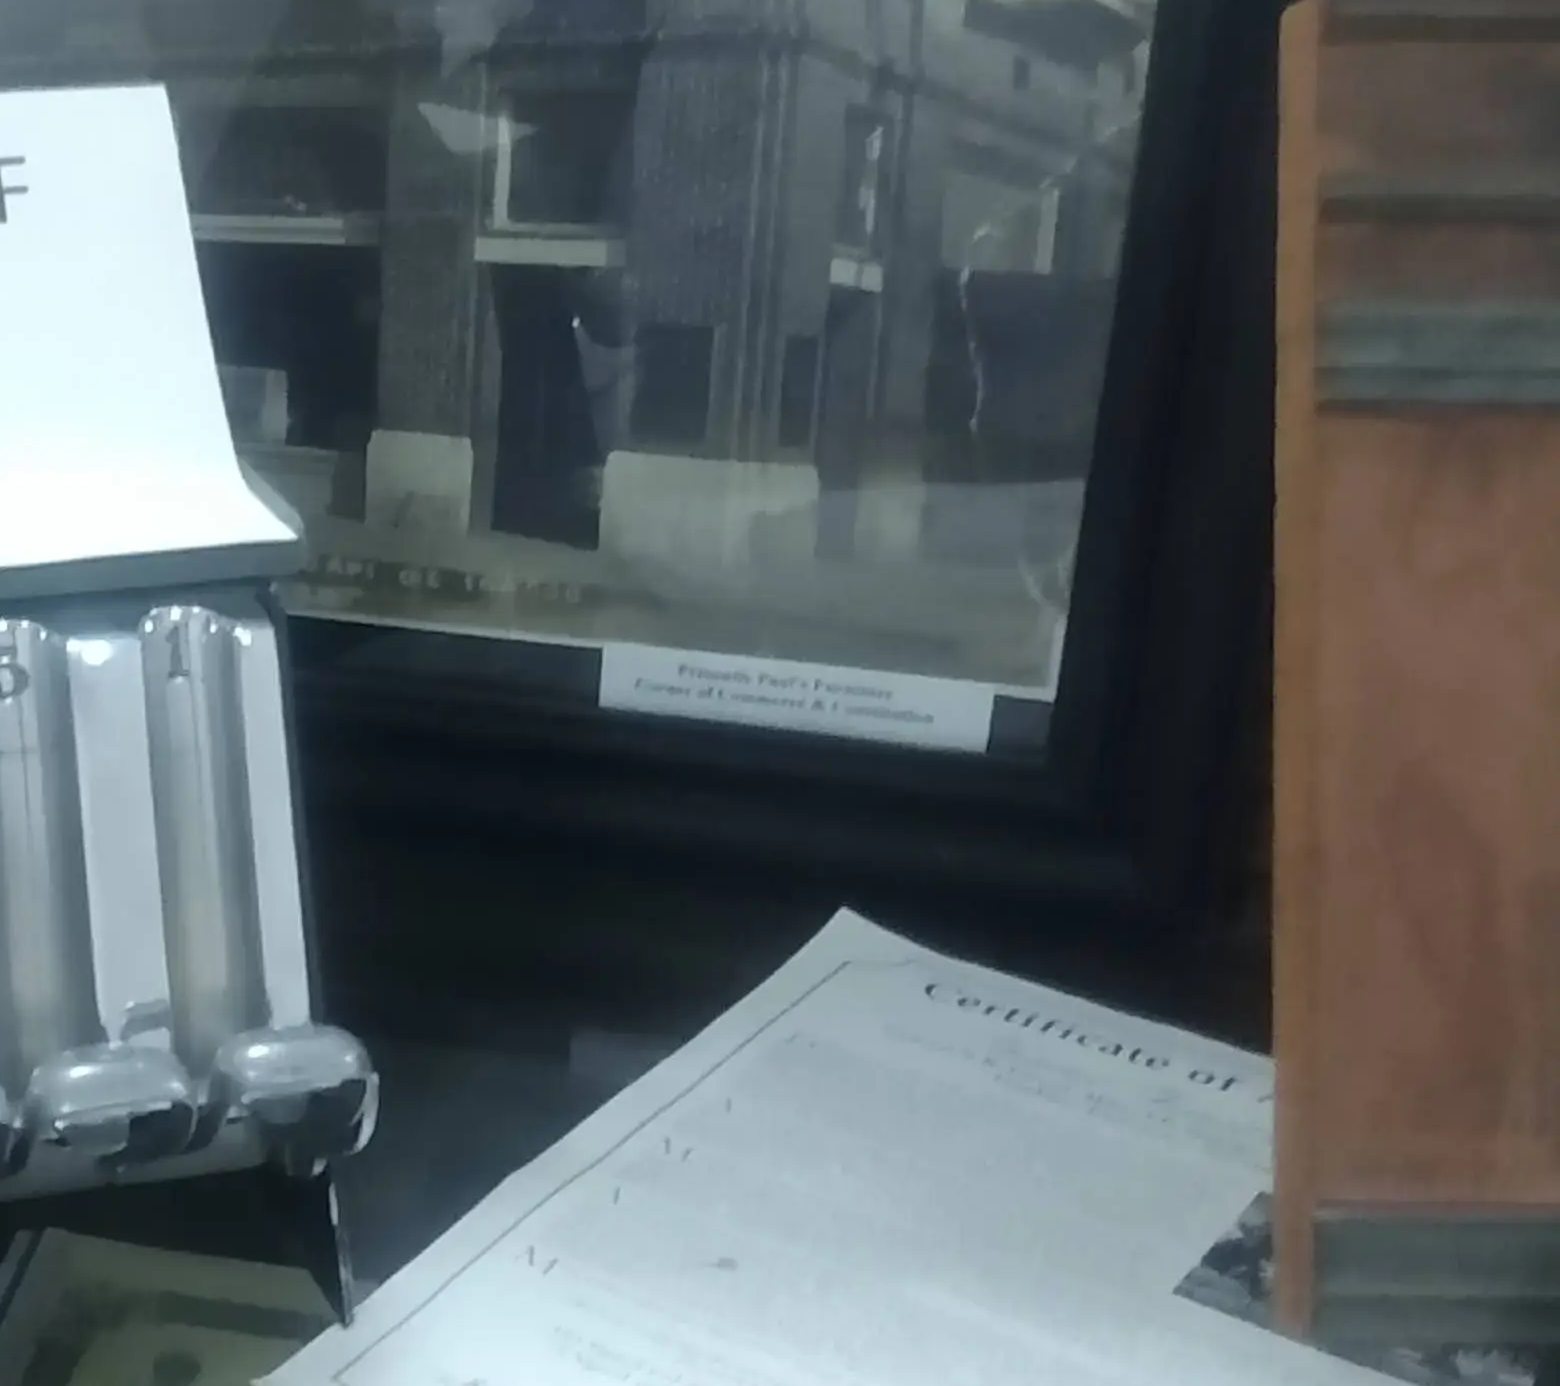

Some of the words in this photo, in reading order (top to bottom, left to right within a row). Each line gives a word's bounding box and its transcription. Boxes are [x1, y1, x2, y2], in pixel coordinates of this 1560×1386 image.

[167, 625, 192, 681] 1
[924, 981, 1173, 1070] Certificate
[1186, 1068, 1239, 1093] of
